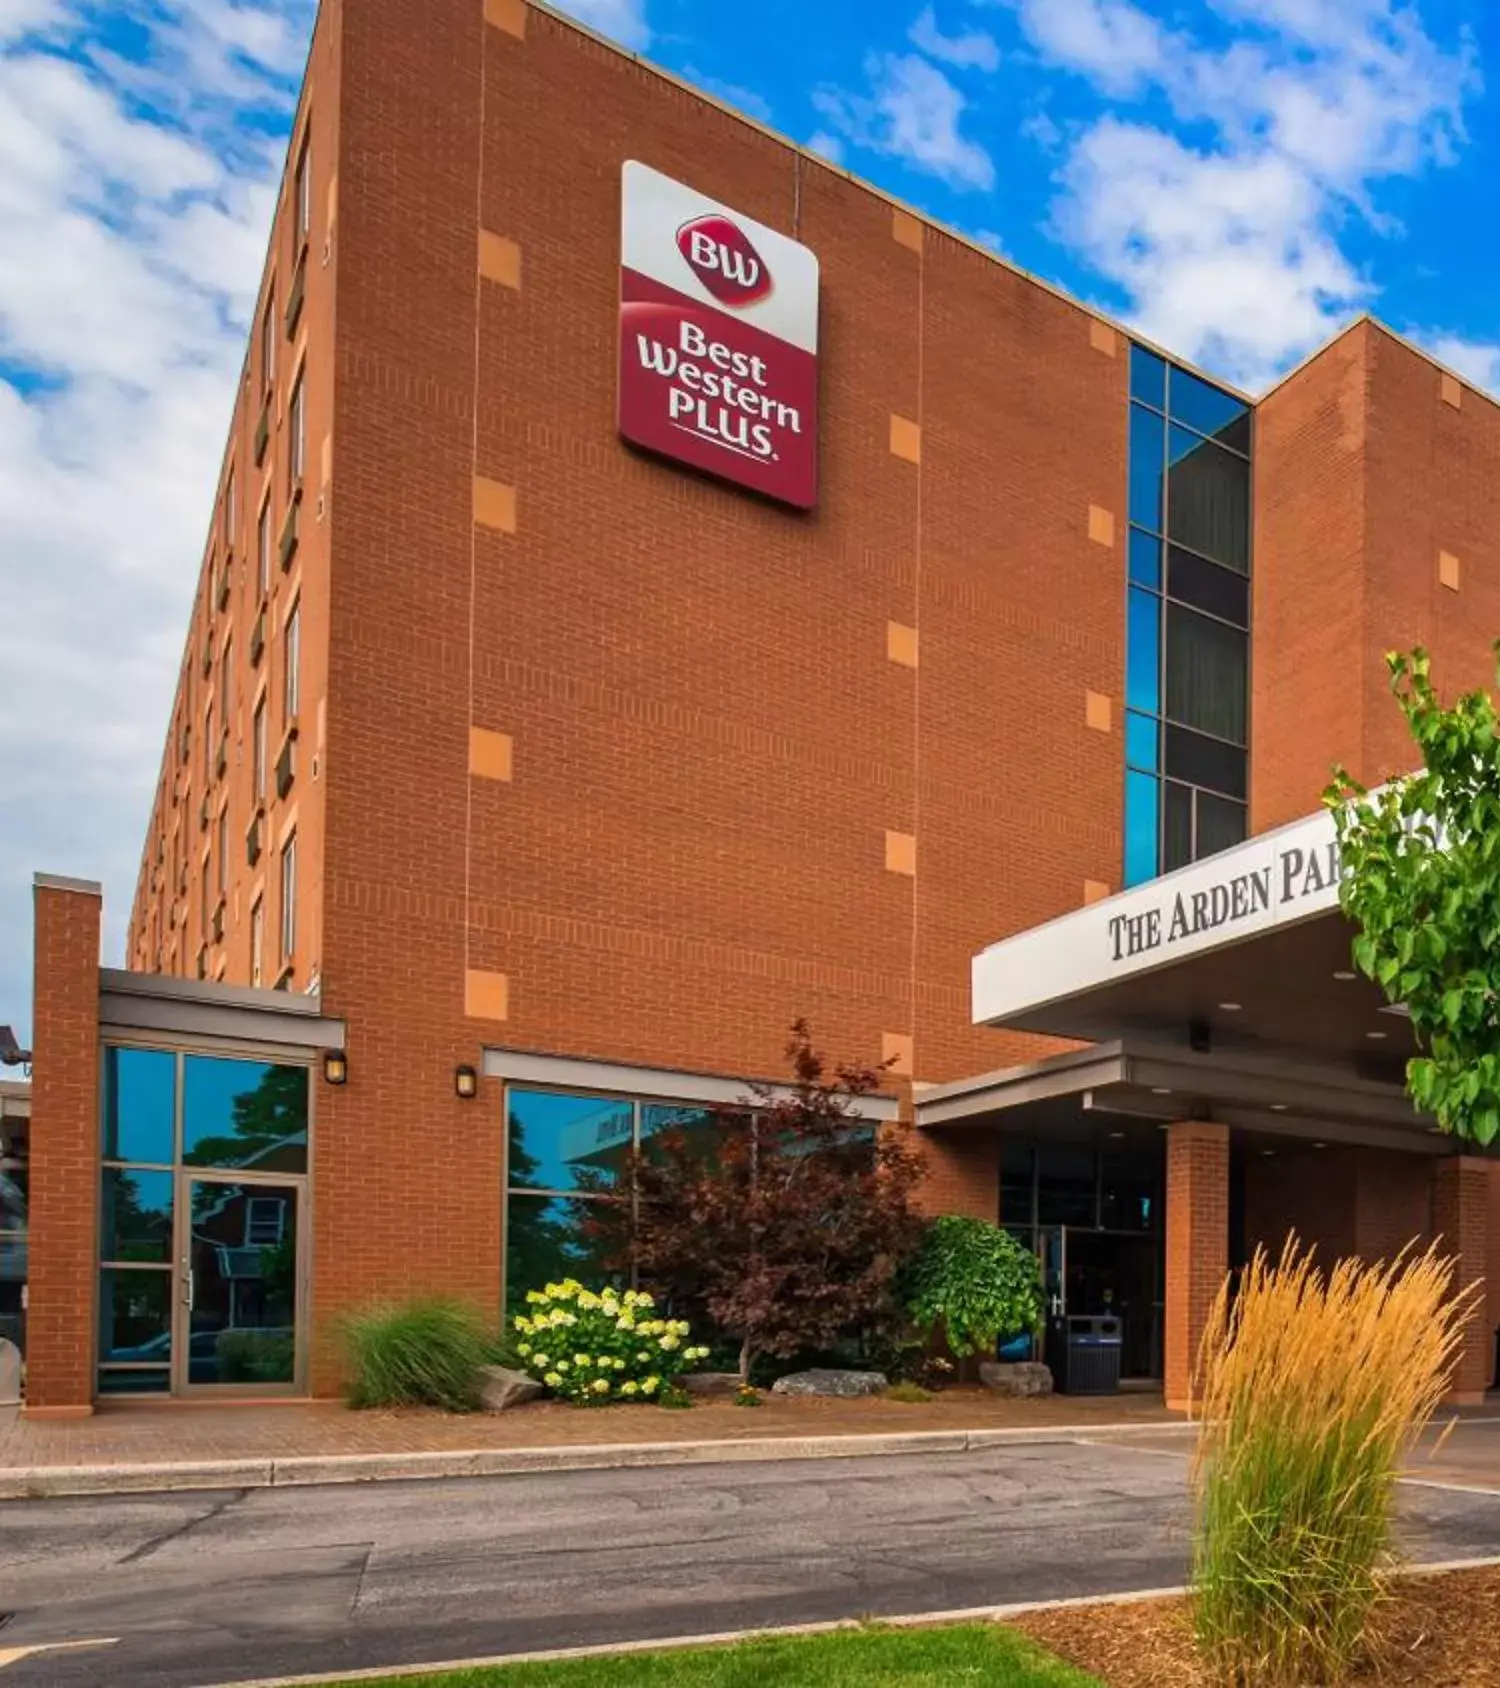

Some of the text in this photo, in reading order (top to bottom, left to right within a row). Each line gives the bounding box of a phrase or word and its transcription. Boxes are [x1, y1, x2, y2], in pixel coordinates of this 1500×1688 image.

[691, 231, 759, 287] BW
[636, 333, 801, 434] Western
[679, 320, 768, 387] Best
[669, 387, 775, 460] PLUS
[1108, 909, 1162, 961] THE
[1167, 865, 1272, 943] ARDEN
